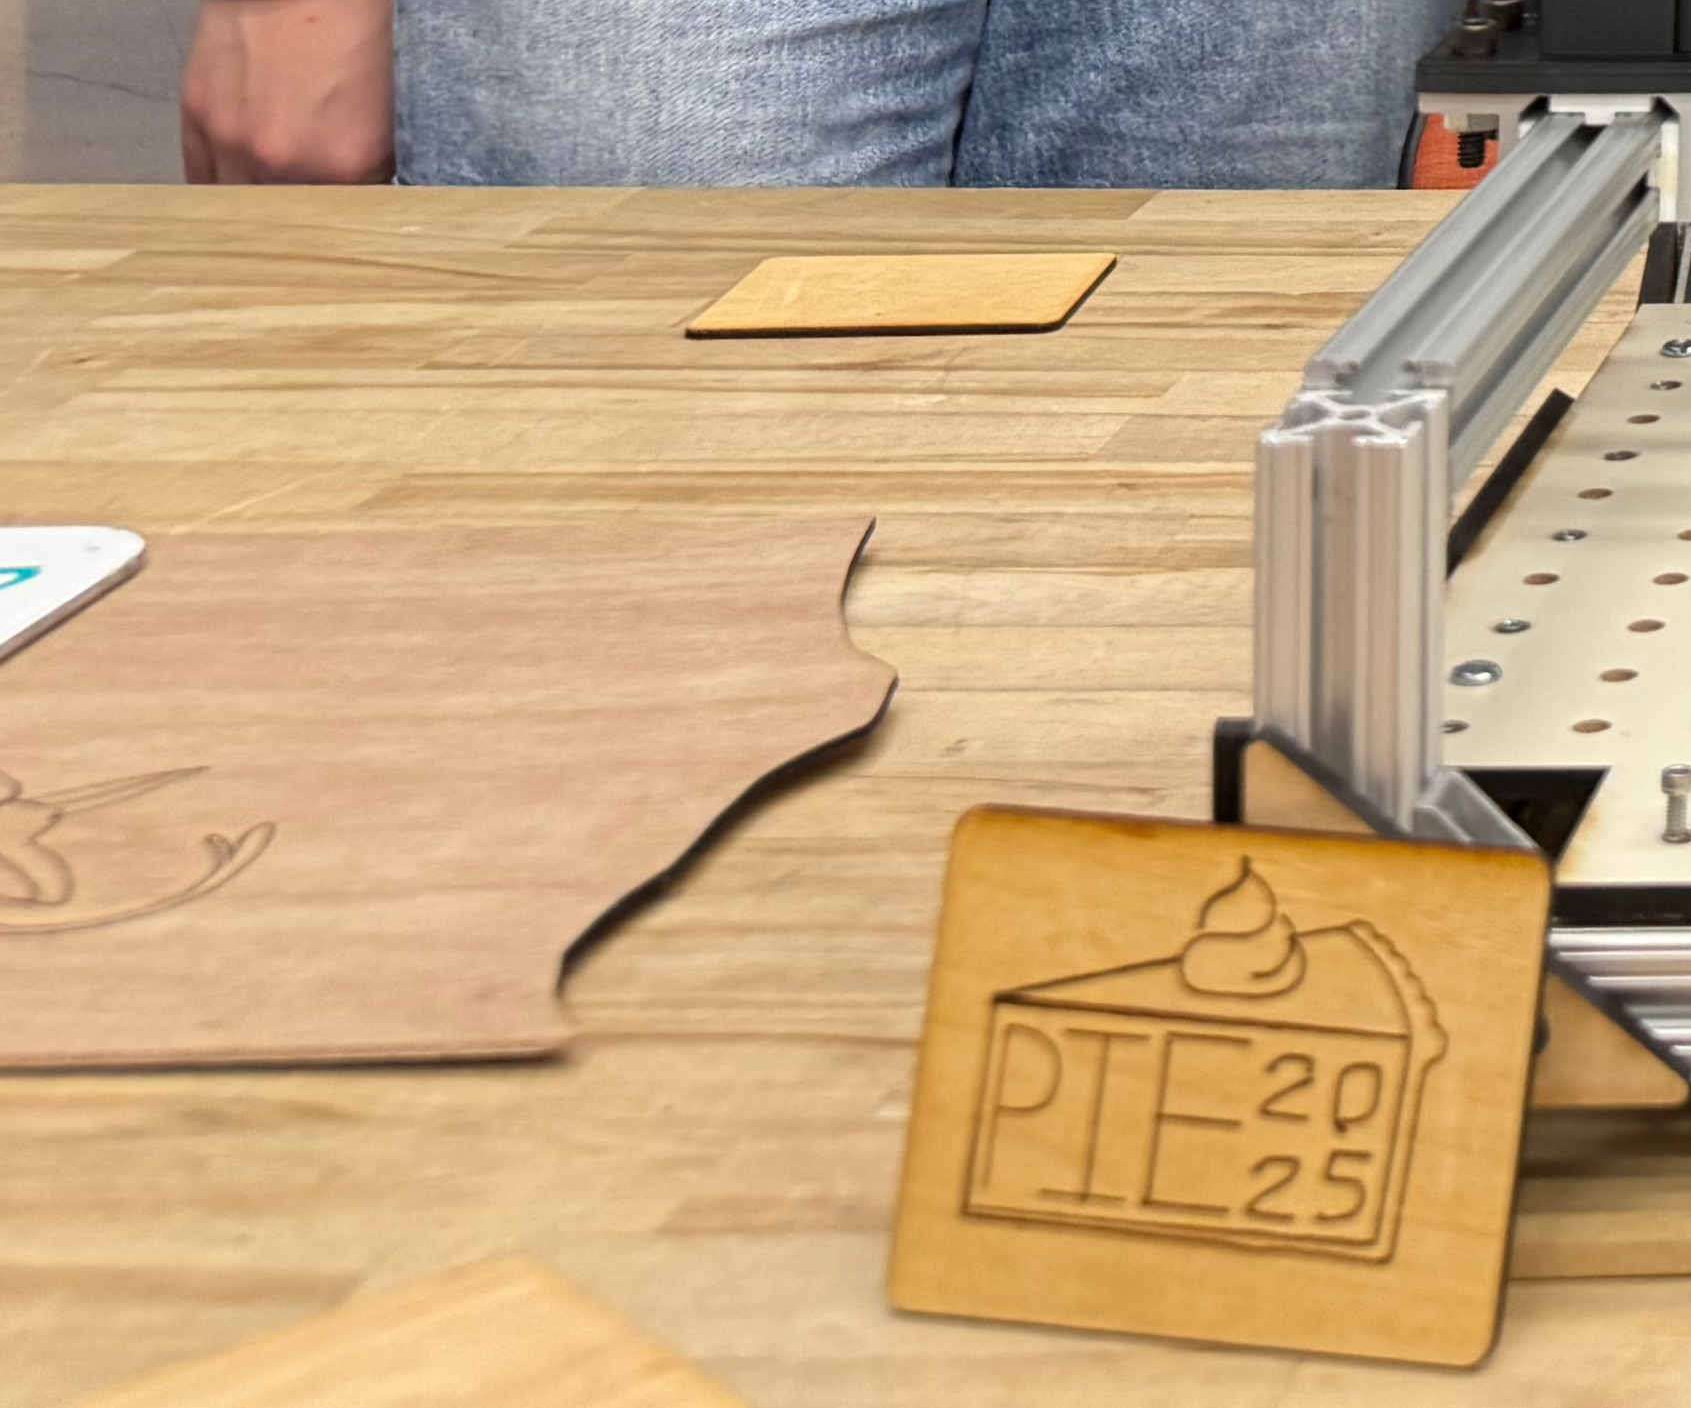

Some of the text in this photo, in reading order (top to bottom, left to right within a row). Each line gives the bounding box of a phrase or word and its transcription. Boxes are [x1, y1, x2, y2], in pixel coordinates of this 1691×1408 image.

[982, 1021, 1386, 1217] PIE 20
[1243, 1149, 1374, 1224] 25
